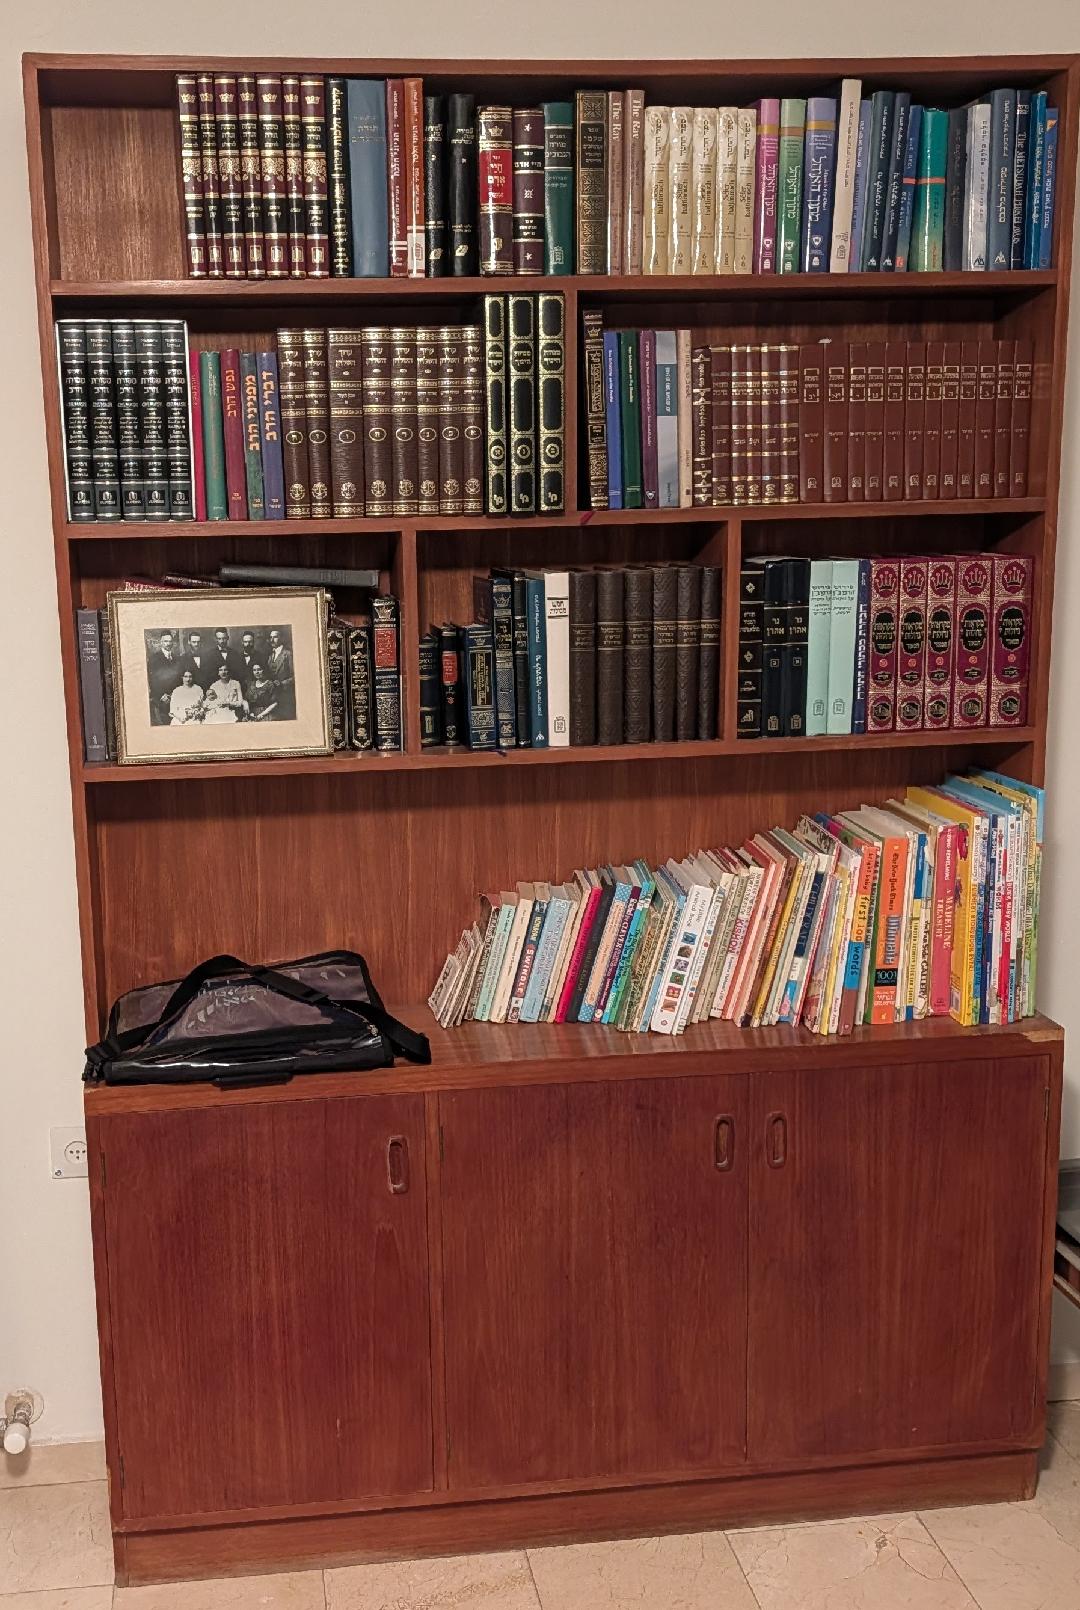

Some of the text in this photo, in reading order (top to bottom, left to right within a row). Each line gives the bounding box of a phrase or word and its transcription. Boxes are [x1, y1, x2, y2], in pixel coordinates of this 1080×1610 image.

[613, 102, 623, 140] The Rav
[633, 100, 643, 139] The Rav
[1017, 132, 1027, 149] The
[786, 165, 800, 219] מתוך האוהל
[807, 156, 827, 222] מתוך האוהל
[225, 370, 237, 417] נפש הרב
[245, 375, 260, 451] מפניני הרב
[262, 371, 277, 440] דברי הרב
[767, 627, 784, 636] אהרן
[865, 852, 874, 873] bright
[796, 881, 819, 947] CHILDCRAFT
[856, 895, 869, 921] first
[934, 898, 945, 938] TREASURY
[940, 895, 954, 949] MADELINE
[726, 917, 744, 954] KISHON
[855, 922, 865, 941] 100
[515, 948, 534, 993] SWINDLE
[849, 945, 862, 976] words
[920, 943, 928, 960] Side
[916, 960, 930, 999] GALLERY
